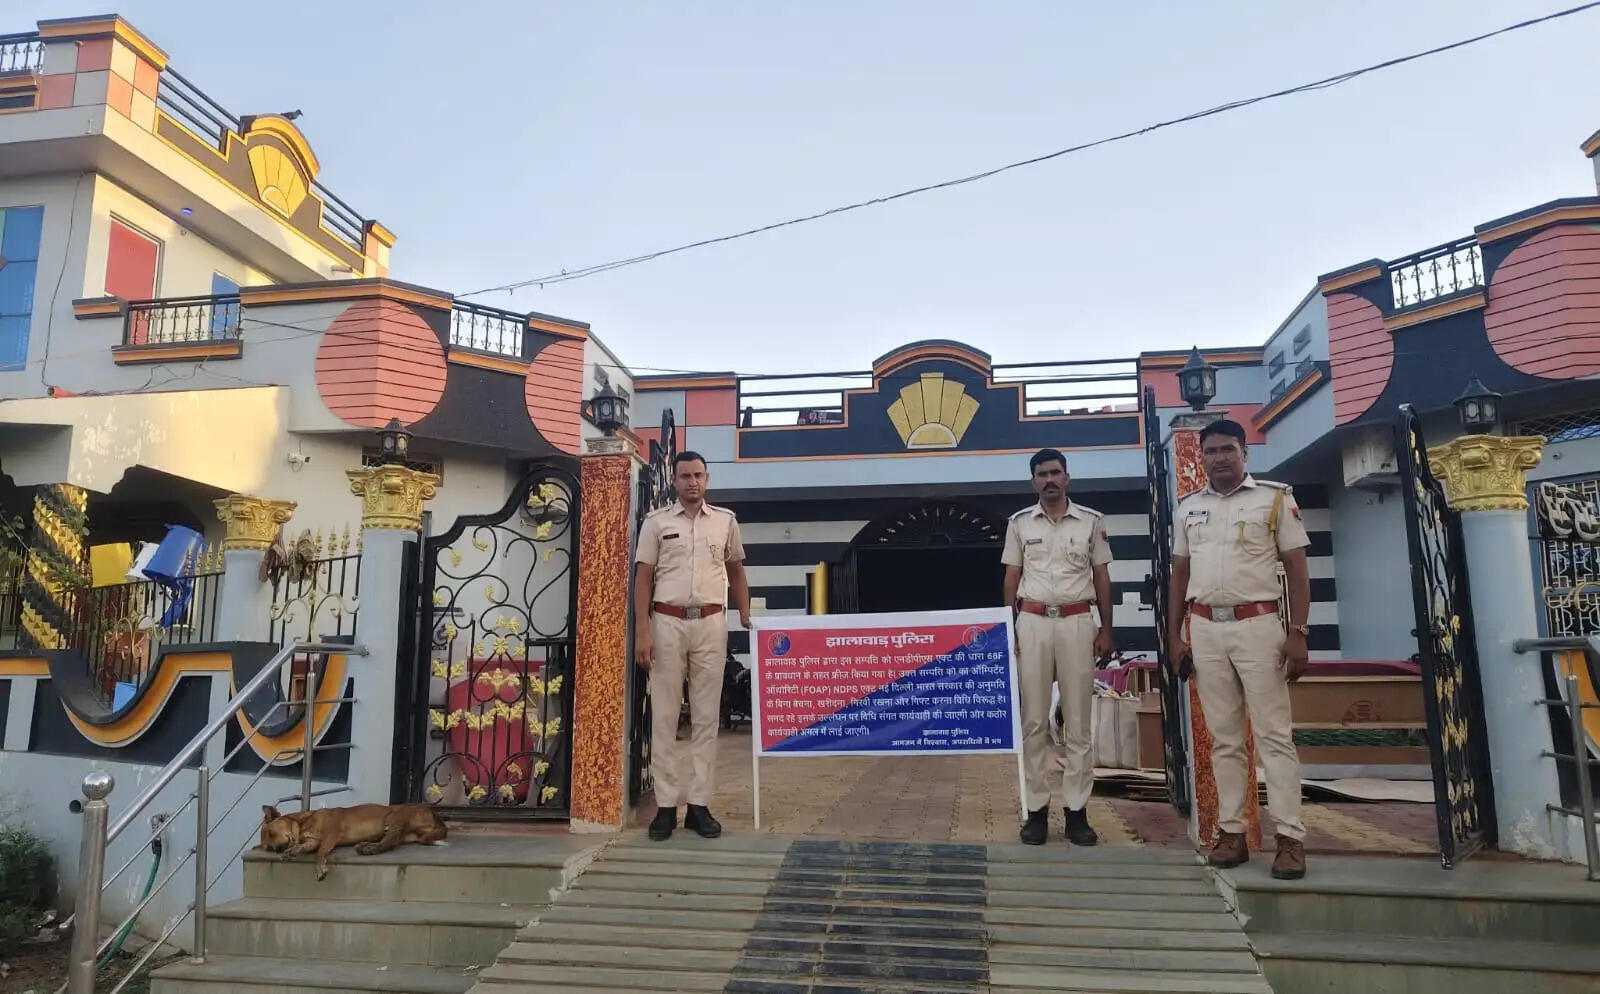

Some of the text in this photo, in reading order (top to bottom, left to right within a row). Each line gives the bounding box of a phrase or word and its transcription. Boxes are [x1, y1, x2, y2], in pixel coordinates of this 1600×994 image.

[891, 632, 936, 648] पुलिस
[799, 655, 820, 668] पुलिस
[822, 657, 838, 666] द्वारा
[840, 657, 852, 665] इस
[881, 653, 891, 663] को
[894, 653, 933, 664] एनडीपीएस
[936, 654, 952, 664] एक्ट
[955, 652, 965, 662] की
[968, 652, 984, 661] धारा
[987, 651, 1004, 660] 68F
[765, 671, 773, 680] के
[774, 672, 801, 681] प्रावधान
[803, 670, 811, 680] के
[813, 671, 830, 680] तहत
[831, 669, 849, 680] फ्रीज
[851, 669, 869, 679] किया
[872, 670, 886, 678] गया
[898, 669, 917, 678] उक्त
[946, 667, 956, 676] को
[800, 685, 831, 697] (FOAP)
[833, 685, 858, 694] NDPS
[860, 685, 877, 694] एक्ट
[878, 683, 889, 693] नई
[891, 682, 914, 693] दिल्ली
[916, 682, 936, 691] भारत
[937, 681, 963, 691] सरकार
[965, 679, 975, 690] की
[977, 679, 1006, 691] अनुमति
[766, 699, 774, 708] के
[775, 698, 791, 708] बिना
[850, 696, 871, 707] गिरवी
[873, 697, 893, 707] रखना
[932, 696, 952, 705] करना
[954, 694, 971, 705] विधि
[786, 712, 796, 723] रहे
[797, 712, 816, 723] इसके
[848, 713, 858, 721] पर
[860, 711, 877, 721] विधि
[879, 711, 897, 721] संगत
[899, 710, 931, 721] कार्यवाही
[932, 709, 942, 720] की
[944, 709, 968, 720] जाएगी
[986, 709, 1007, 719] कठोर
[800, 727, 819, 737] अमल
[828, 726, 843, 737] लाई
